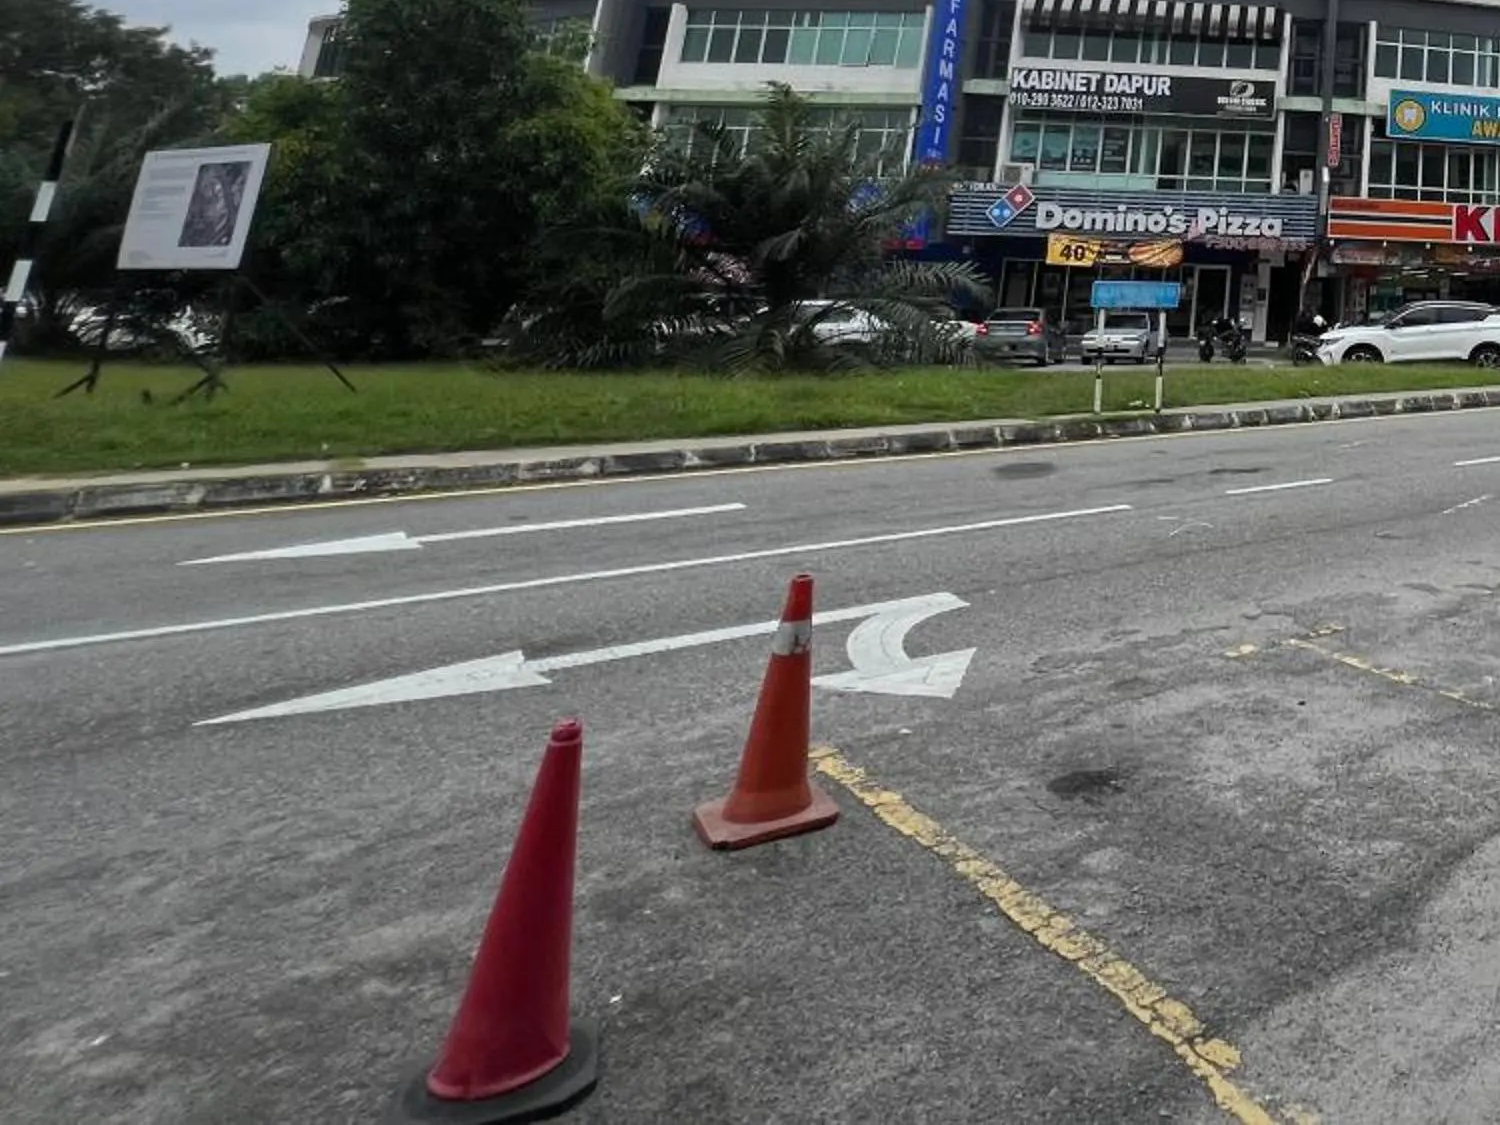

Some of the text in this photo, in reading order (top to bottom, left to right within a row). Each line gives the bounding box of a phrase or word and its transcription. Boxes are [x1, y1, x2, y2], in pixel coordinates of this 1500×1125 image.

[1012, 69, 1171, 96] KABINET DAPUR
[1430, 100, 1491, 119] KLINIK
[1036, 203, 1283, 237] Domino's Pizza
